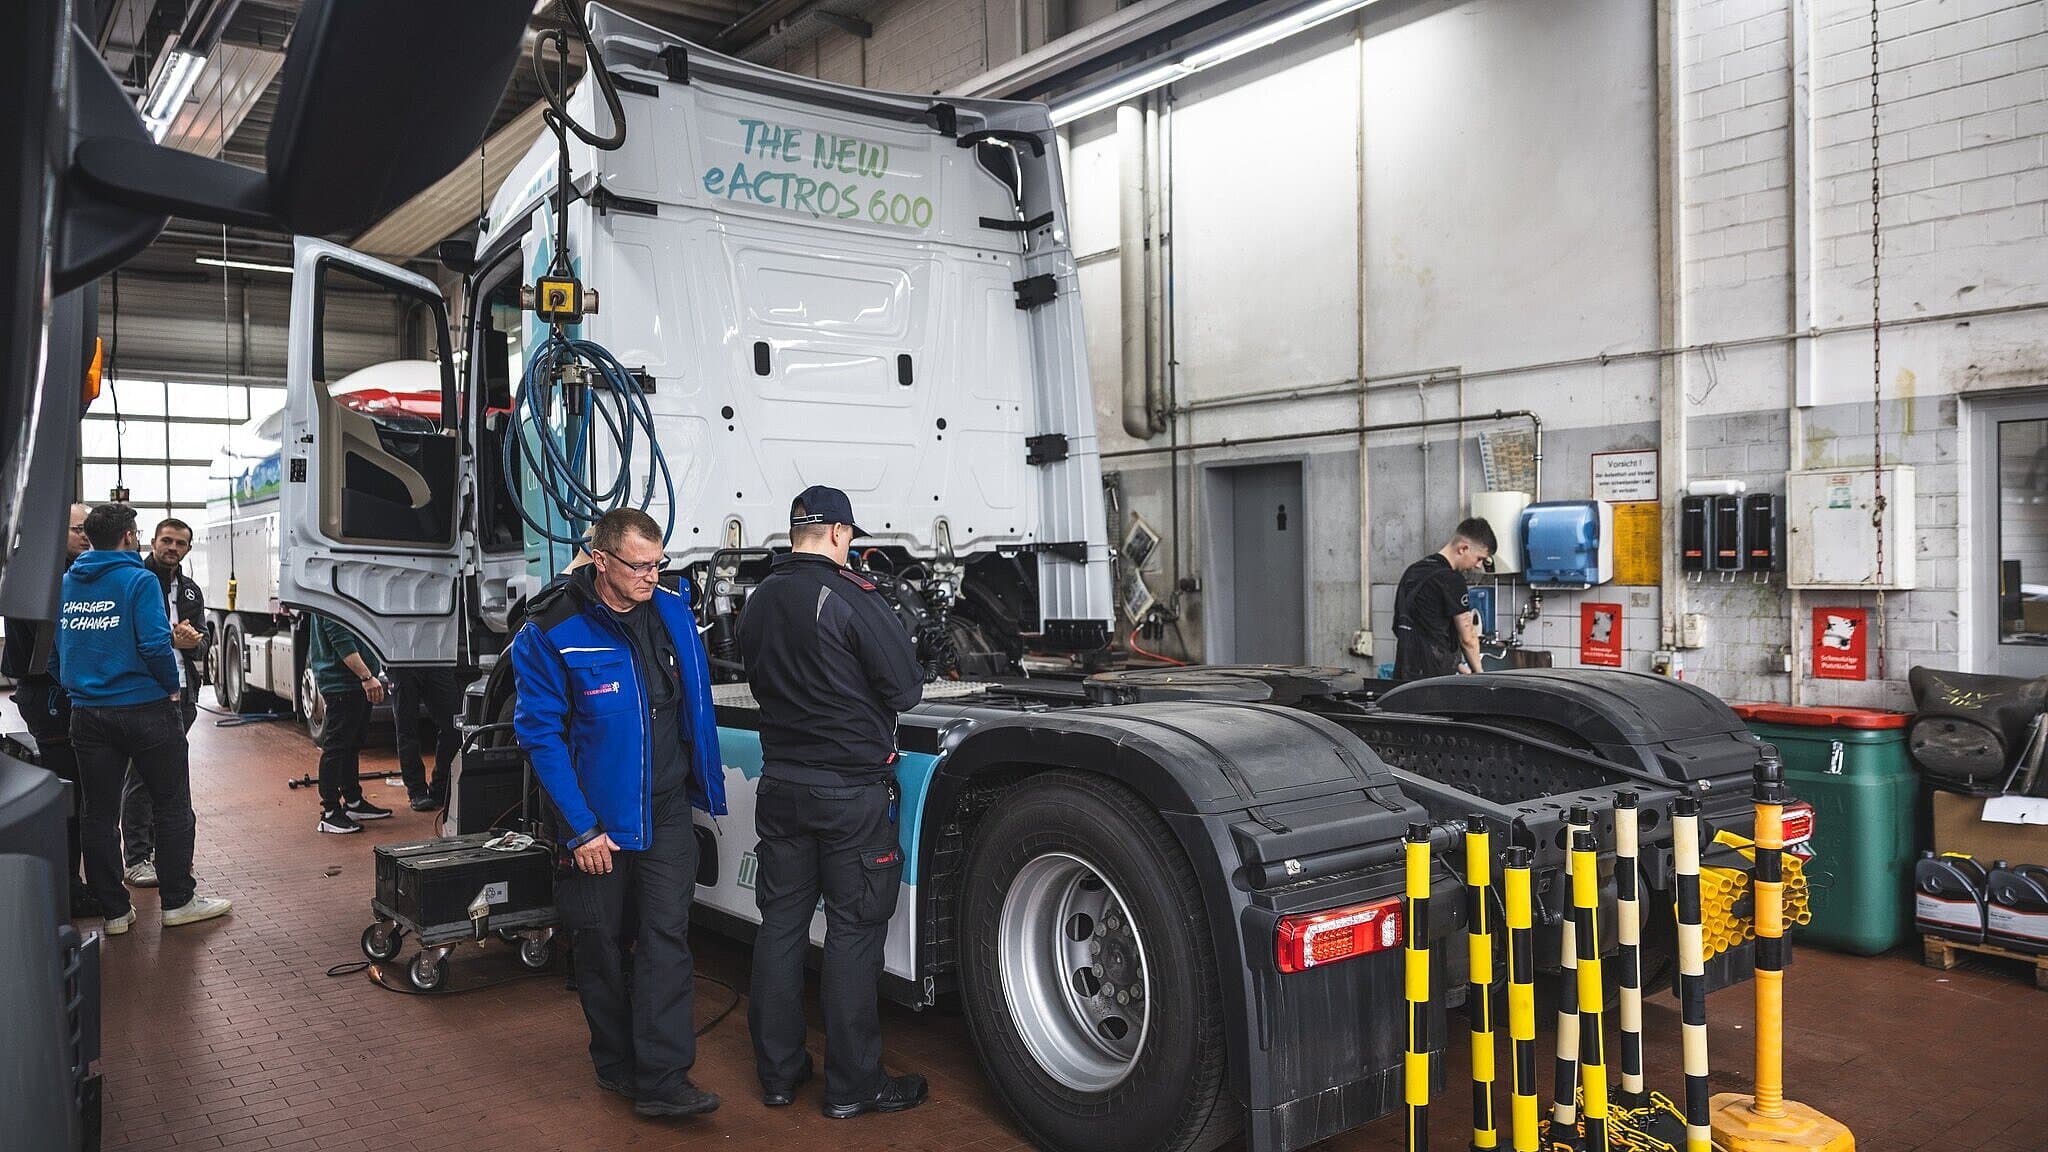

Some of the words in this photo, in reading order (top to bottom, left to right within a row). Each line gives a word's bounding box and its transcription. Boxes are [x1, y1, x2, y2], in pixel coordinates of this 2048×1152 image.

[738, 119, 801, 162] THE
[813, 133, 889, 178] NEW
[703, 162, 861, 219] eACTROS
[868, 189, 933, 229] 600
[63, 601, 115, 613] CHARGED
[70, 616, 120, 631] CHANGE
